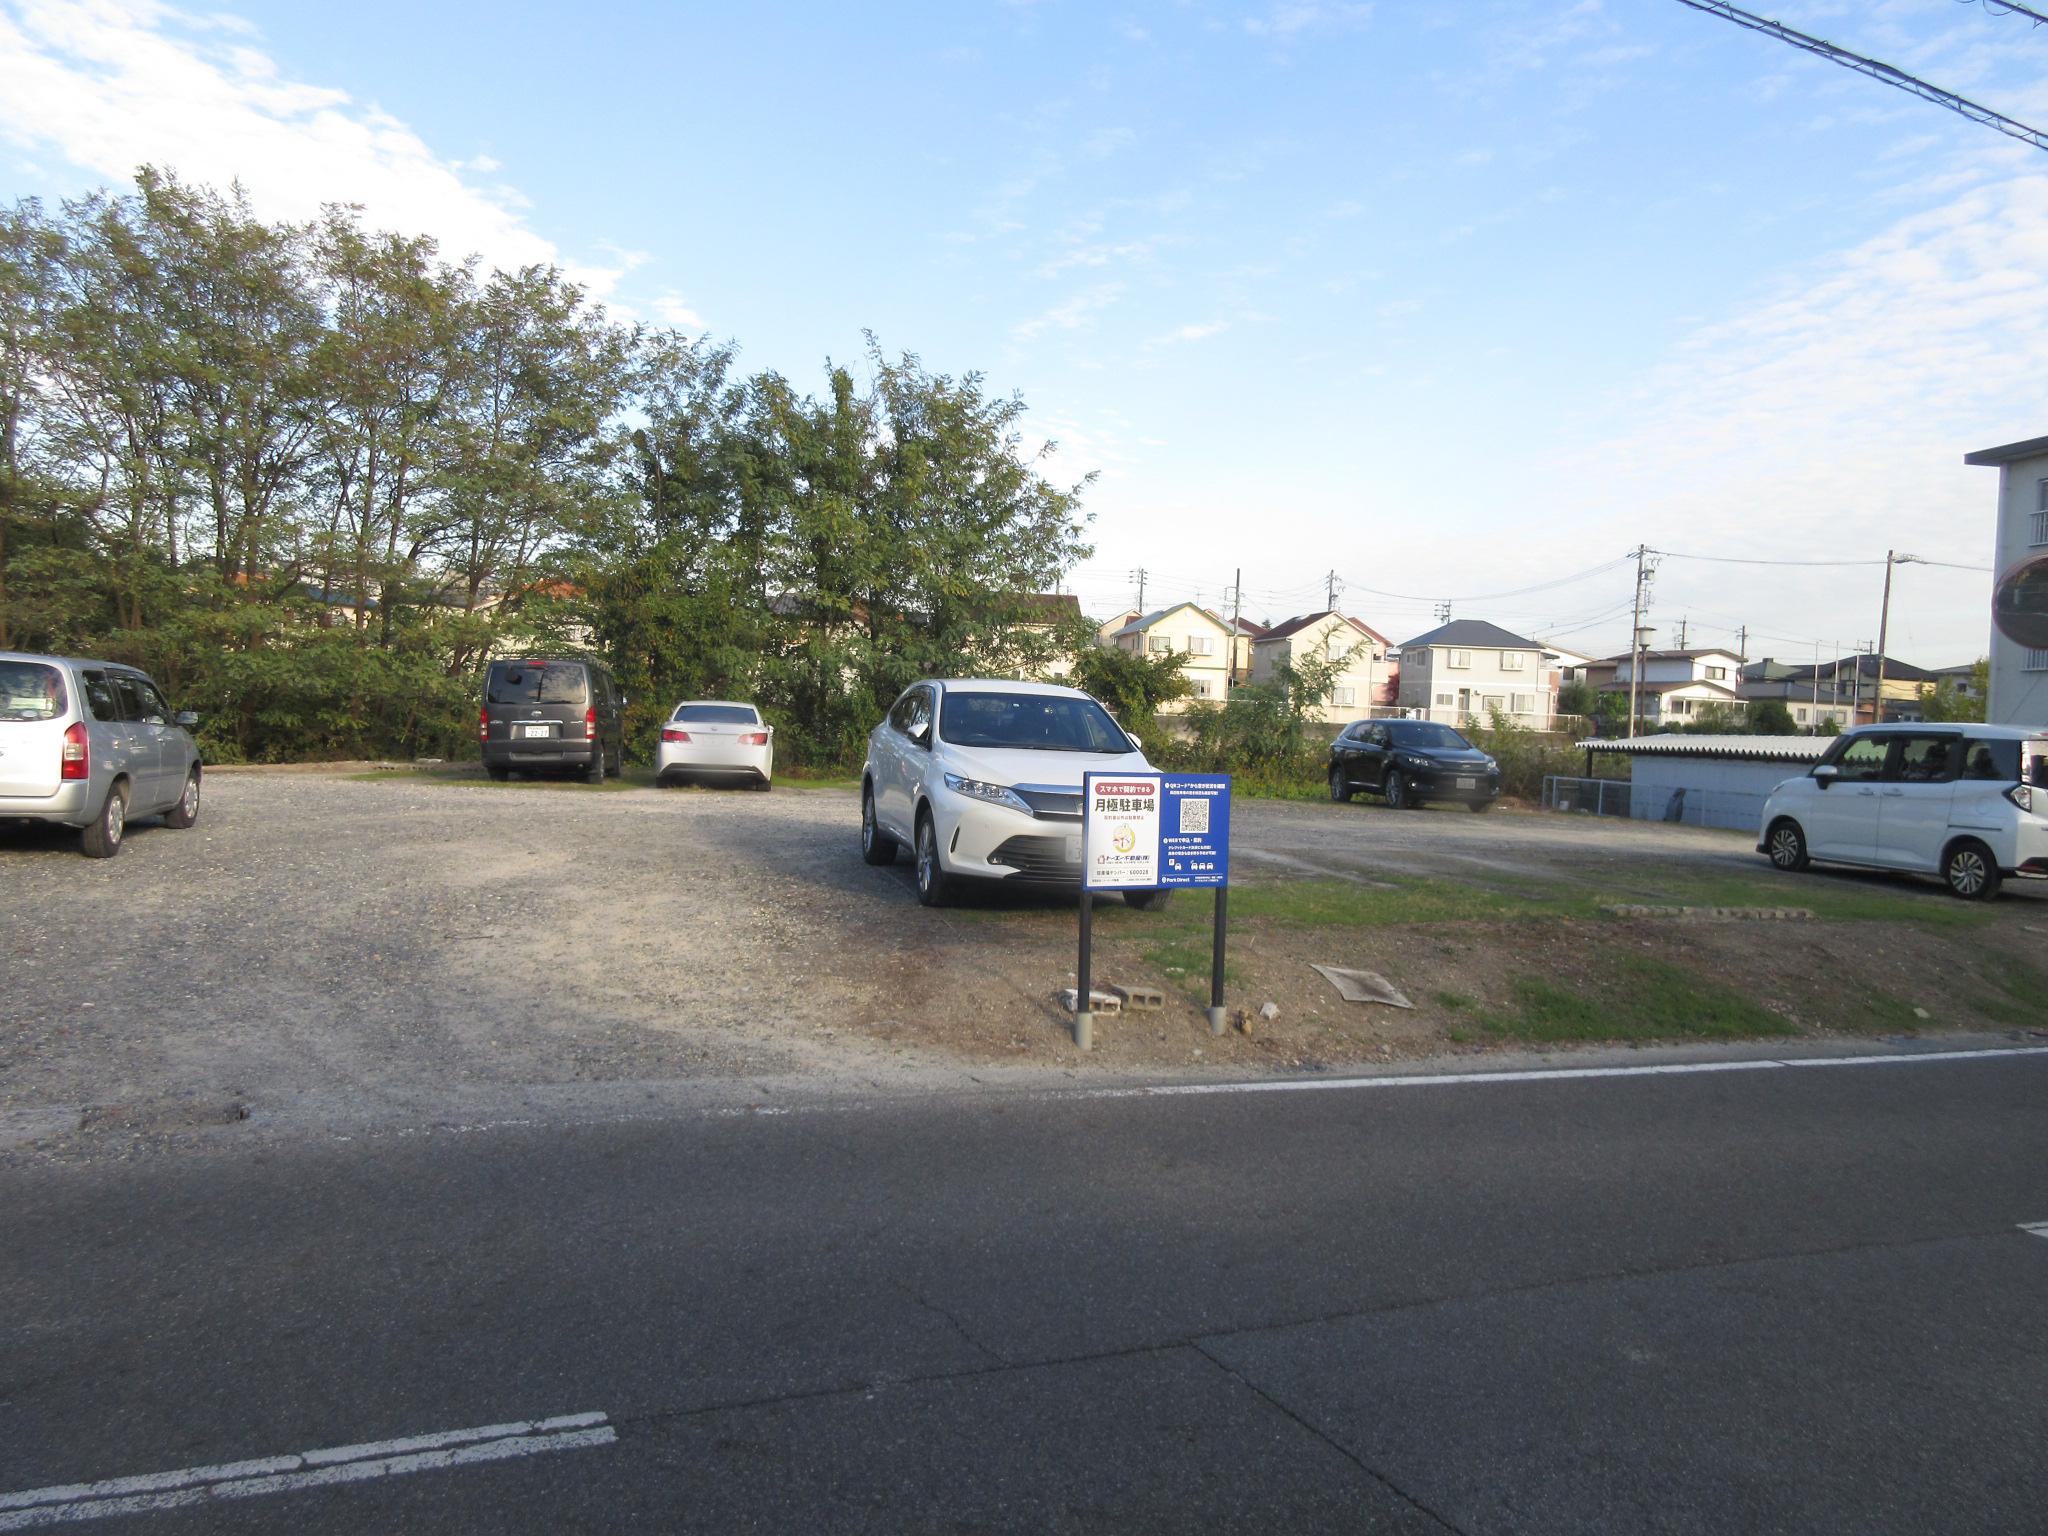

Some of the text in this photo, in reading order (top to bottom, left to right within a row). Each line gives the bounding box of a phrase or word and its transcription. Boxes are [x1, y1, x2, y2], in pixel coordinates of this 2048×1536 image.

[1100, 785, 1151, 793] スマホで契約できる
[1095, 798, 1155, 812] 月極駐車場
